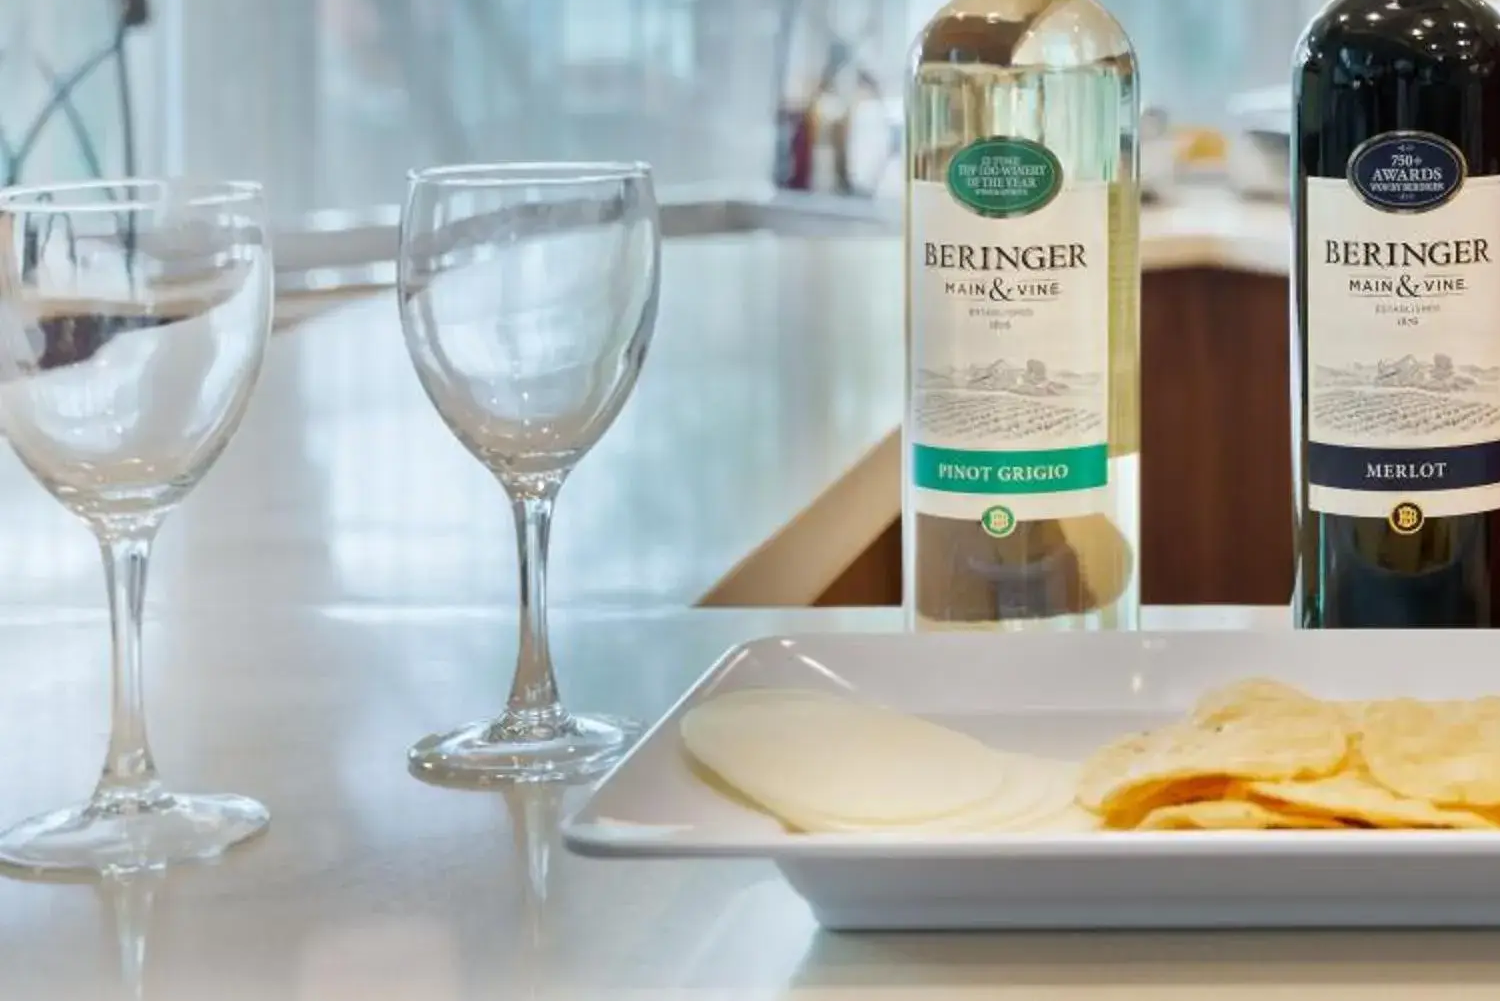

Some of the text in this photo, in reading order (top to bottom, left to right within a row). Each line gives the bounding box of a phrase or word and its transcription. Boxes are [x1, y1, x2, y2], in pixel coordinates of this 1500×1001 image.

[982, 177, 1002, 188] THE
[1005, 177, 1037, 188] YEAR
[1373, 167, 1443, 181] AWARDS
[924, 241, 1088, 271] BERINGER
[1325, 238, 1492, 267] BERINGER
[945, 276, 1062, 301] MAIN & VINE
[1349, 274, 1466, 298] MAIN & VINE
[938, 462, 1069, 482] PINOT GRIGIO
[1365, 462, 1447, 479] MERLOT
